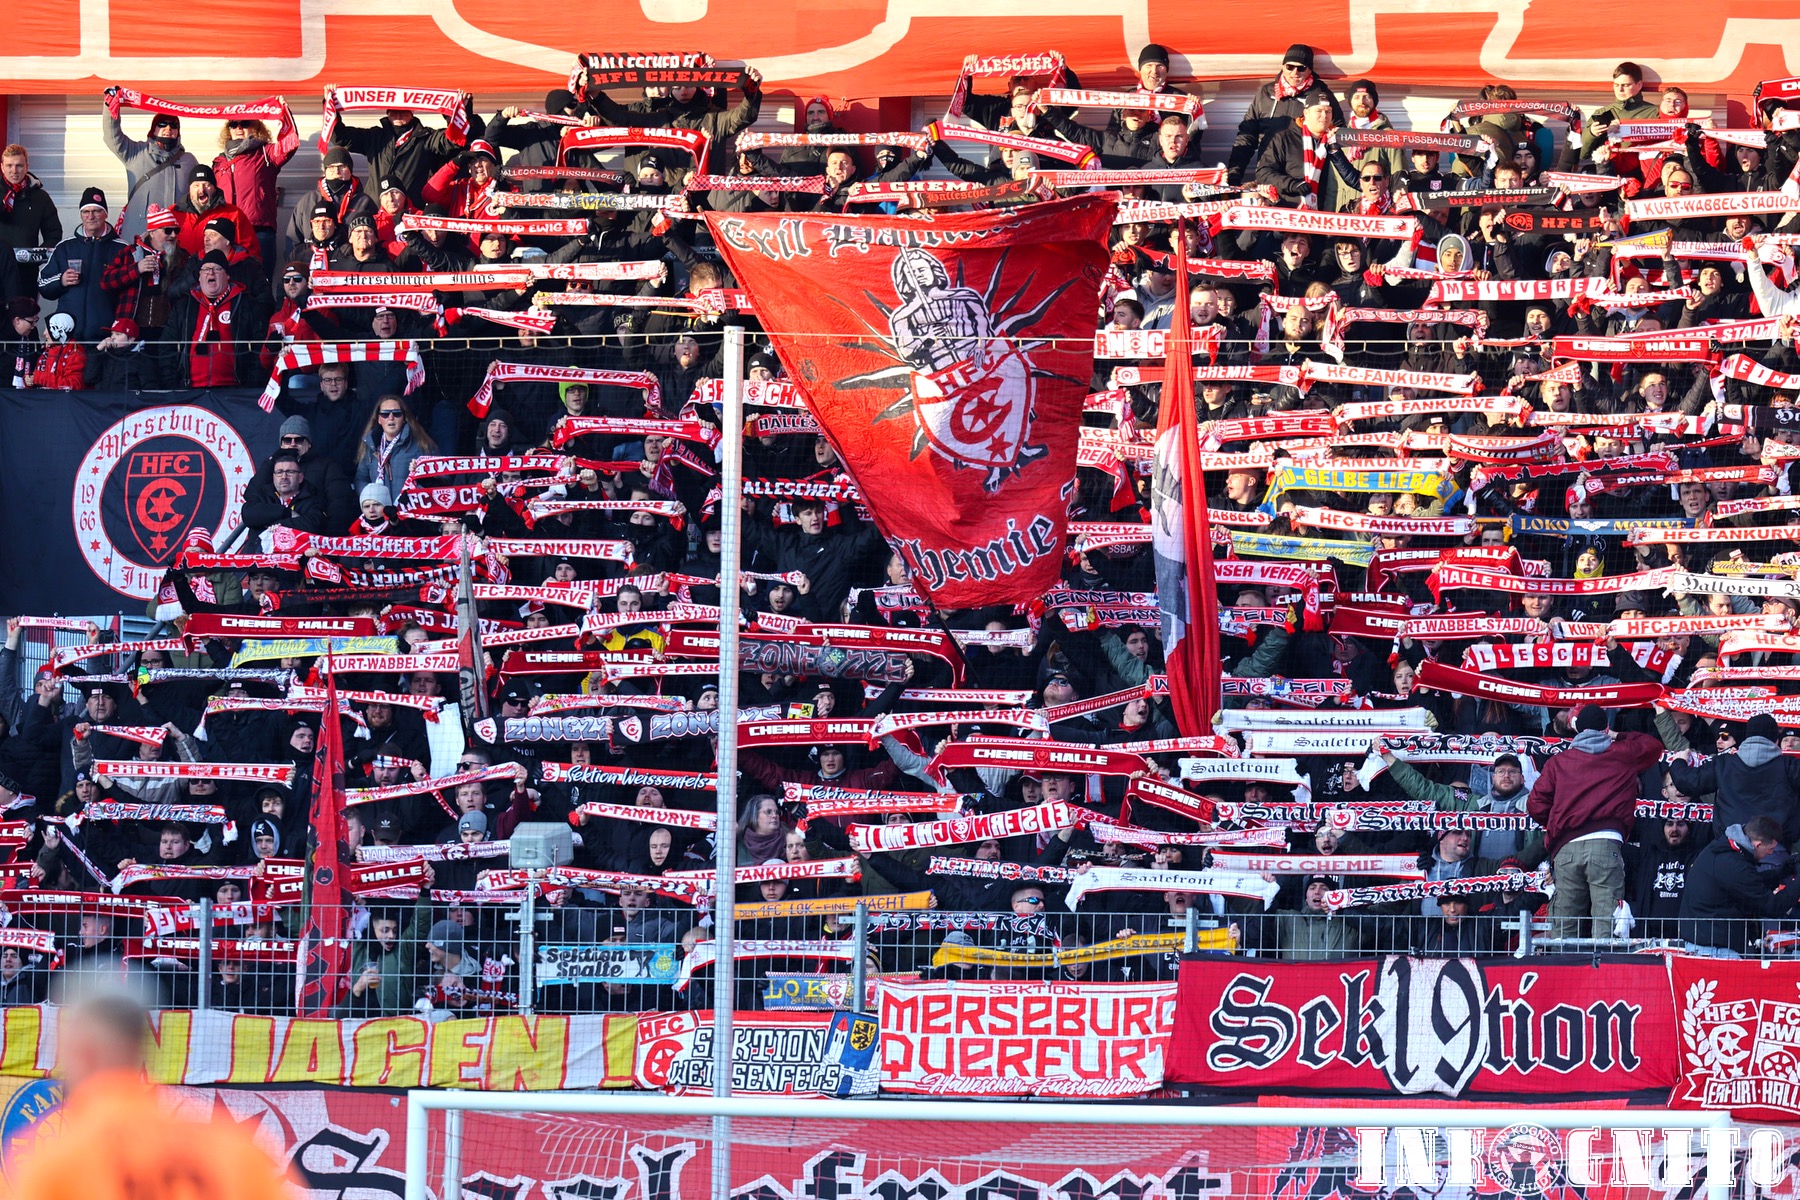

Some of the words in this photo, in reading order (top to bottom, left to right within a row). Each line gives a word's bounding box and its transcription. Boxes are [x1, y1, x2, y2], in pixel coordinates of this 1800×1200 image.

[592, 71, 637, 85] HFC
[652, 71, 741, 84] CHEMIE
[344, 90, 396, 103] UNSER
[403, 91, 457, 109] VEREIN
[1050, 91, 1151, 108] HALLESCHER
[1154, 94, 1176, 109] FC
[576, 130, 628, 141] CHEMIE
[644, 128, 698, 142] HALLE
[1340, 134, 1399, 143] HALLESCHER
[1402, 135, 1472, 148] FUSSBALLCLUB
[1046, 145, 1075, 157] ALONE
[1057, 171, 1196, 184] TRADITIONSVEREIN
[926, 187, 990, 203] Hallescher
[996, 180, 1023, 196] FC
[421, 218, 444, 230] FÜR
[447, 221, 493, 231] IMMER
[497, 223, 525, 232] UND
[529, 223, 563, 232] EWIG
[1248, 210, 1385, 229] HFC-FANKURVE
[1541, 217, 1584, 228] HFC
[721, 217, 810, 260] Exil
[344, 272, 436, 286] Merseburger
[451, 272, 496, 285] Jungs
[1721, 322, 1779, 342] STADT
[1572, 341, 1631, 351] CHEMIE
[1645, 341, 1702, 351] HALLE
[524, 367, 586, 378] UNSER
[938, 346, 995, 396] HFC
[1196, 366, 1256, 379] CHEMIE
[1326, 366, 1454, 387] HFC-FANKURVE
[1094, 391, 1117, 402] FC
[1361, 405, 1397, 416] HFC
[1402, 398, 1494, 412] FANKURVE
[95, 409, 236, 460] Merseburger
[1232, 419, 1330, 434] HFC
[141, 455, 190, 474] HFC
[1616, 475, 1664, 484] DANKE
[81, 484, 95, 504] 19
[80, 511, 96, 530] 66
[1320, 512, 1455, 532] HFC-FANKURVE
[1520, 518, 1570, 530] LOKO
[309, 537, 416, 553] HALLESCHER
[420, 540, 440, 552] FC
[490, 537, 615, 558] HFC-FANKURVE
[1379, 550, 1440, 562] CHEMIE
[1456, 549, 1512, 559] HALLE
[1214, 563, 1254, 577] NSER
[570, 580, 600, 593] HFC
[1439, 571, 1492, 586] HALLE
[1499, 579, 1575, 592] UNSERE
[1582, 571, 1646, 590] STADT
[1682, 573, 1769, 595] Halloren
[1351, 592, 1406, 604] HALLE
[221, 617, 282, 628] CHEMIE
[298, 620, 354, 630] HALLE
[414, 610, 434, 624] 55
[812, 628, 870, 639] CHEMIE
[886, 632, 942, 644] HALLE
[526, 653, 583, 662] CHEMIE
[603, 653, 654, 664] HALLE
[1478, 680, 1541, 698] CHEMIE
[1558, 691, 1618, 700] HALLE
[892, 710, 1034, 726] HFC-FANKURVE
[749, 724, 810, 736] CHEMIE
[973, 749, 1034, 761] CHEMIE
[1051, 752, 1108, 765] HALLE
[1190, 761, 1280, 774] Saalefront
[565, 764, 620, 784] Sektion
[621, 768, 709, 789] Weissenfels
[1138, 781, 1200, 809] CHEMIE
[361, 866, 423, 880] HALLE
[1248, 860, 1294, 871] HFC
[1299, 858, 1384, 872] CHEMIE
[1120, 872, 1214, 886] Saalefront
[22, 894, 82, 903] CHEMIE
[99, 898, 159, 908] HALLE
[236, 942, 294, 950] HALLE
[546, 946, 627, 963] Sektion
[556, 960, 624, 978] Spalte
[989, 985, 1081, 995] SEKTION
[1704, 1003, 1746, 1021] HFC
[639, 1016, 685, 1038] HFC
[692, 1027, 826, 1062] SKTION
[668, 1060, 841, 1093] WEISENFELS
[918, 1071, 1025, 1094] Hallescher
[1029, 1073, 1151, 1095] Fussballclub
